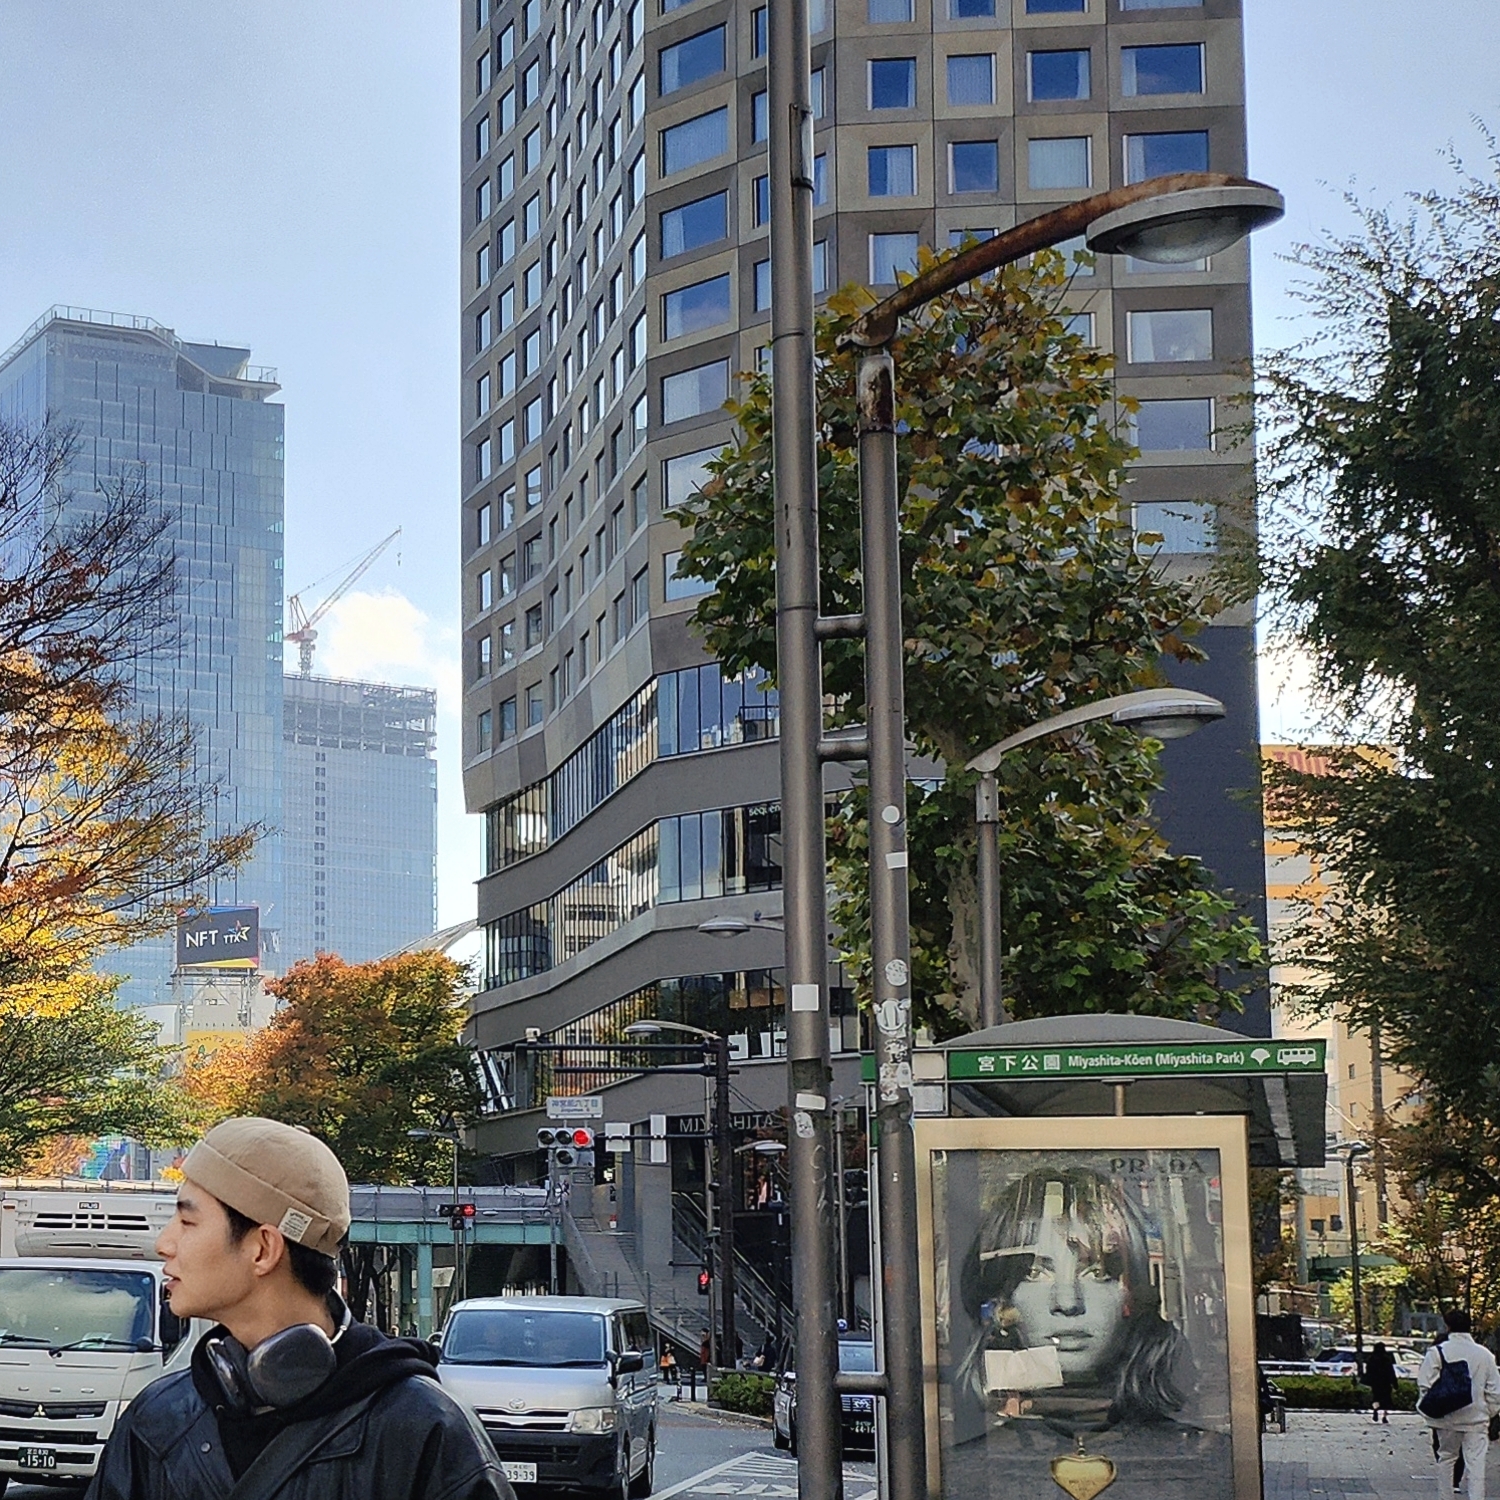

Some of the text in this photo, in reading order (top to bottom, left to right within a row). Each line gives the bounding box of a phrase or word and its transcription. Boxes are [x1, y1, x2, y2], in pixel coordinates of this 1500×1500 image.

[185, 929, 219, 948] NFT
[977, 1055, 1062, 1072] 宮下公園
[1155, 1053, 1211, 1068] (Miyashita
[1215, 1051, 1245, 1066] Park)
[1109, 1157, 1206, 1174] PRDA
[27, 1454, 55, 1467] 15-10
